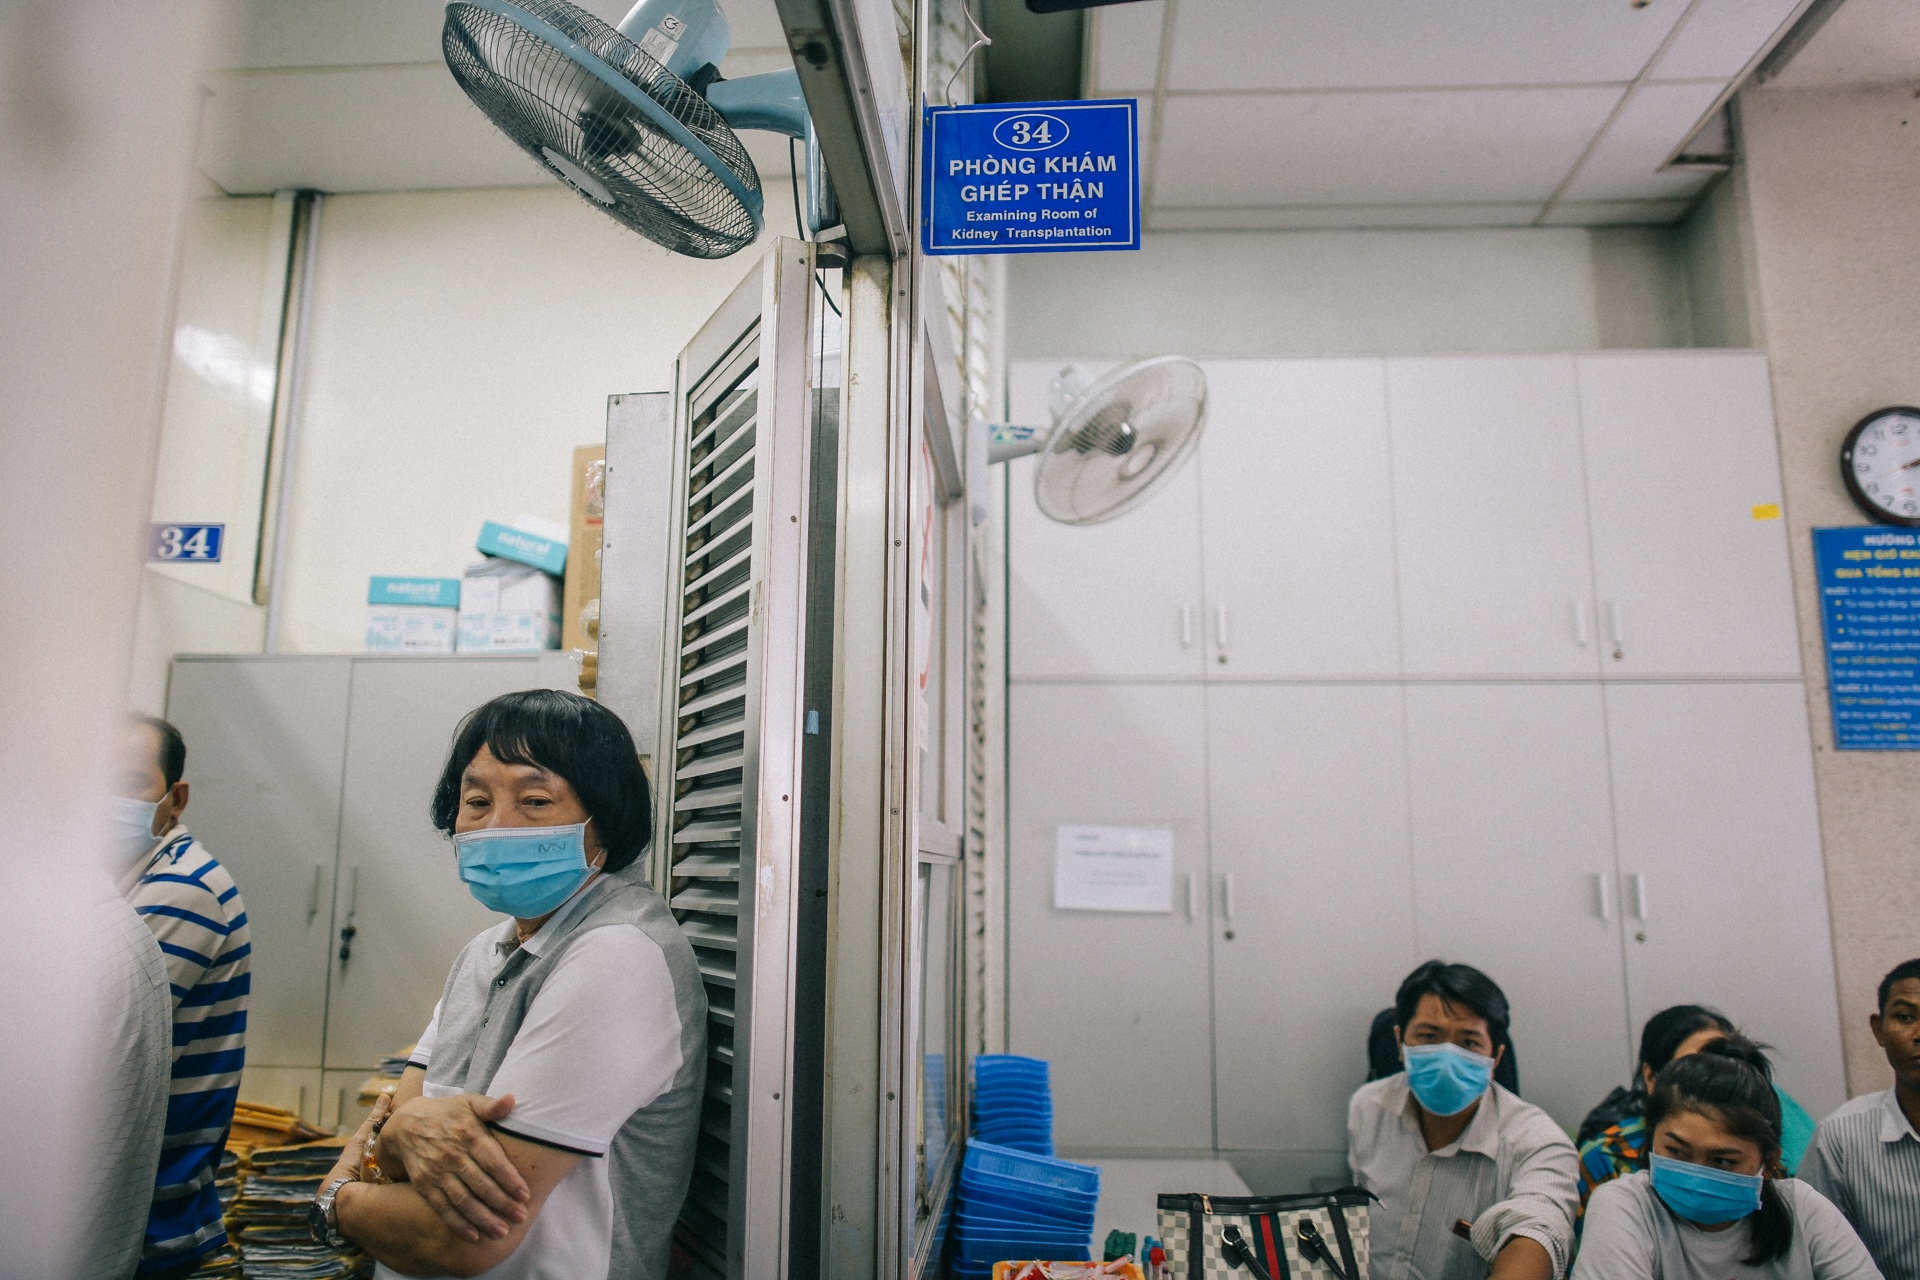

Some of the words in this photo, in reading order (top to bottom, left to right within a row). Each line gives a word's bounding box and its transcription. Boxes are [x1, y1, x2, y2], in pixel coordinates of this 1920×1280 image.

[1011, 120, 1052, 145] 34
[949, 154, 1036, 176] PHÒNG
[1044, 151, 1117, 174] KHÁM
[960, 179, 1029, 202] GHÉP
[1036, 178, 1104, 203] THẬN
[966, 210, 1037, 222] Examining
[1041, 208, 1080, 220] Room
[1084, 207, 1098, 219] of
[952, 228, 998, 241] Kidney
[1006, 225, 1112, 240] Transplantation
[158, 526, 210, 559] 34
